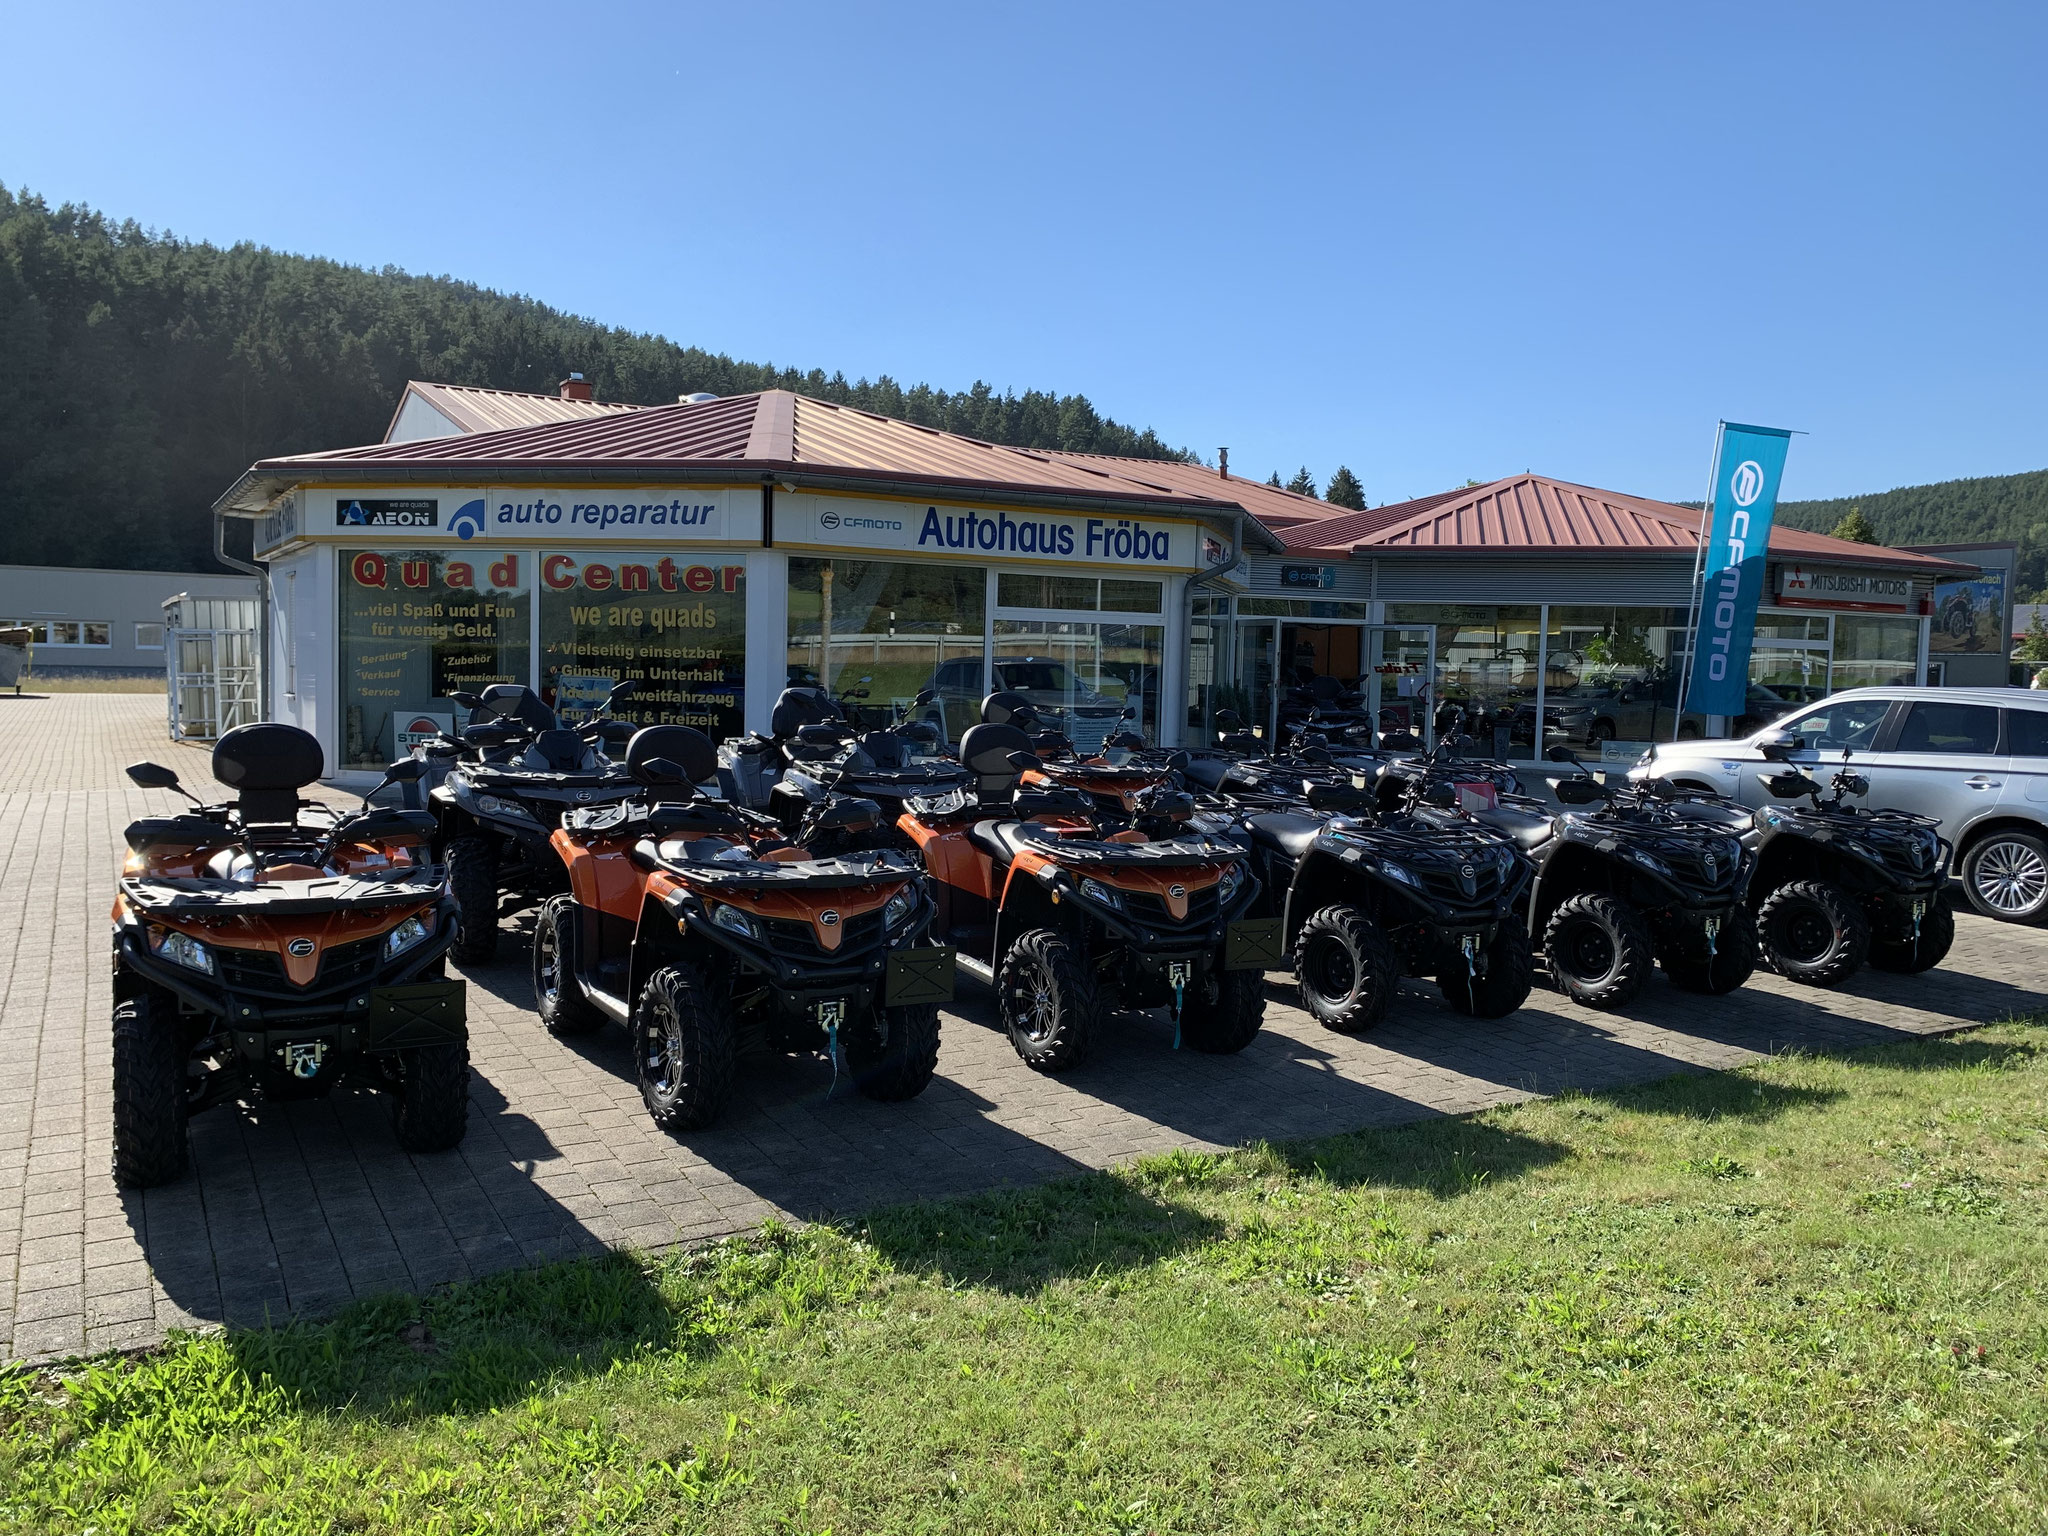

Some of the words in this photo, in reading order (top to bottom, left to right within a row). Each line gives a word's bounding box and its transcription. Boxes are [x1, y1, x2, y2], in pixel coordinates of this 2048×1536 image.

[410, 501, 430, 509] quads
[371, 511, 430, 526] AEON
[497, 499, 562, 524] auto
[571, 499, 715, 530] reparatur
[843, 517, 902, 531] CFMOTO
[917, 506, 1075, 556] Autohaus
[1085, 518, 1170, 561] Fröba
[351, 552, 519, 590] Quad
[541, 554, 746, 593] Center
[1300, 572, 1332, 581] CFMOTO
[1810, 574, 1868, 593] MITSUBISHI
[1869, 578, 1908, 596] MOTORS
[1708, 510, 1750, 682] CFMOTO
[402, 603, 444, 620] Spaß
[448, 603, 480, 618] und
[484, 603, 516, 618] Fun
[570, 605, 601, 625] we
[608, 605, 643, 627] are
[650, 602, 717, 633] quads
[371, 622, 394, 636] für
[399, 623, 449, 640] wenig
[453, 623, 497, 638] Geld.
[561, 642, 635, 659] Vielseitig
[639, 645, 722, 660] einsetzbar
[561, 664, 621, 682] Günstig
[625, 667, 645, 680] im
[650, 668, 725, 682] Unterhalt
[643, 710, 655, 724] &
[660, 711, 720, 727] Freizeit
